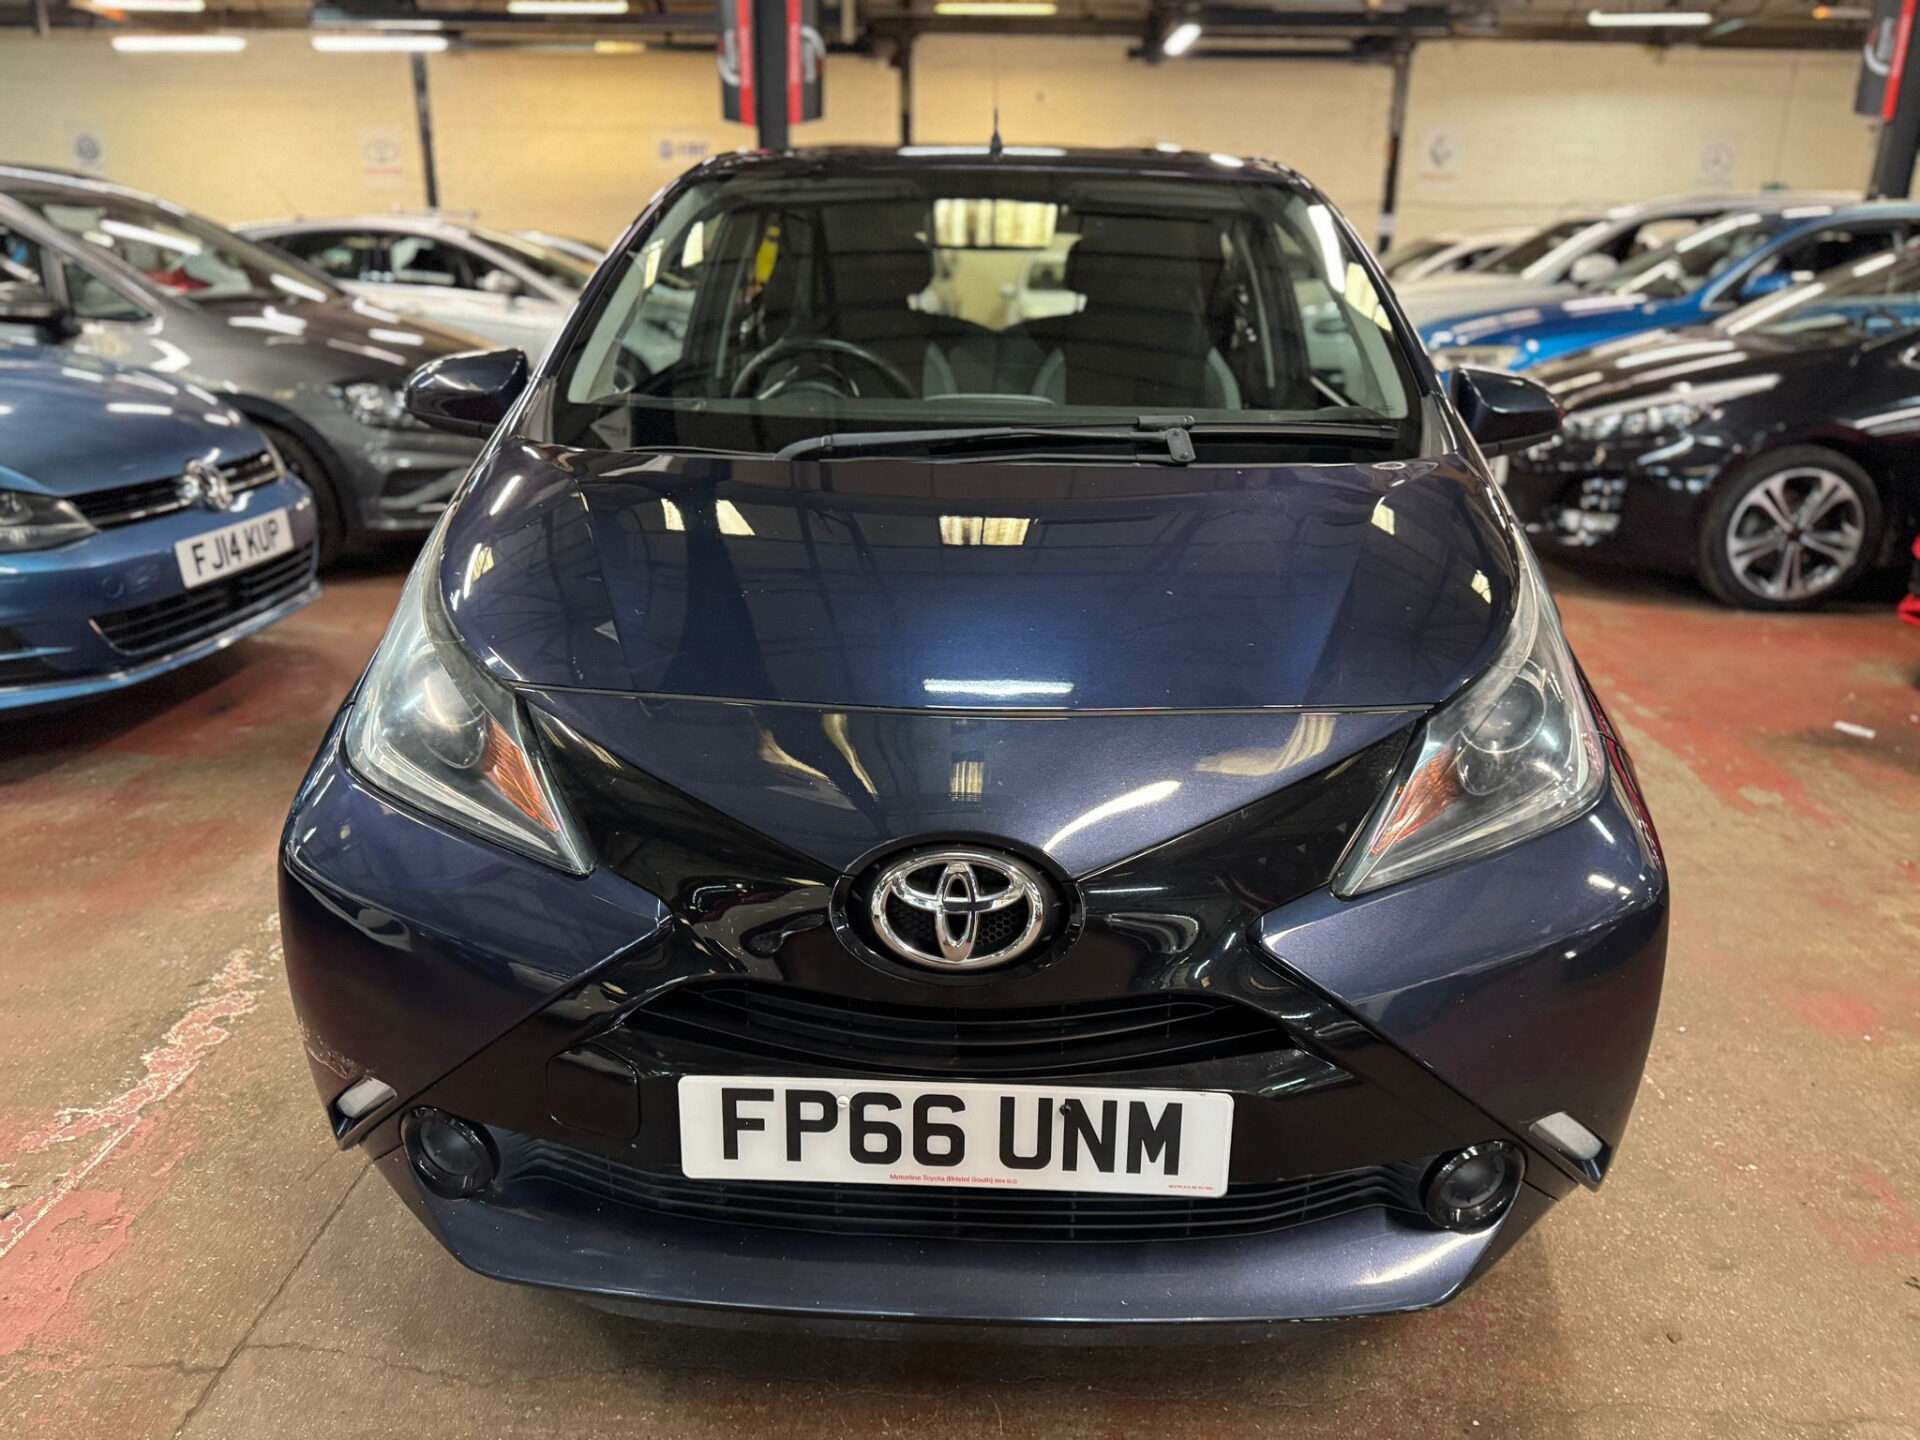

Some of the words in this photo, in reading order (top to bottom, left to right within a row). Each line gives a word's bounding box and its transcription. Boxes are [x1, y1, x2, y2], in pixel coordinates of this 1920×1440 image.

[191, 530, 242, 577] FJ14
[244, 518, 279, 559] KUP
[721, 1087, 967, 1167] FP66
[999, 1095, 1183, 1176] UNM
